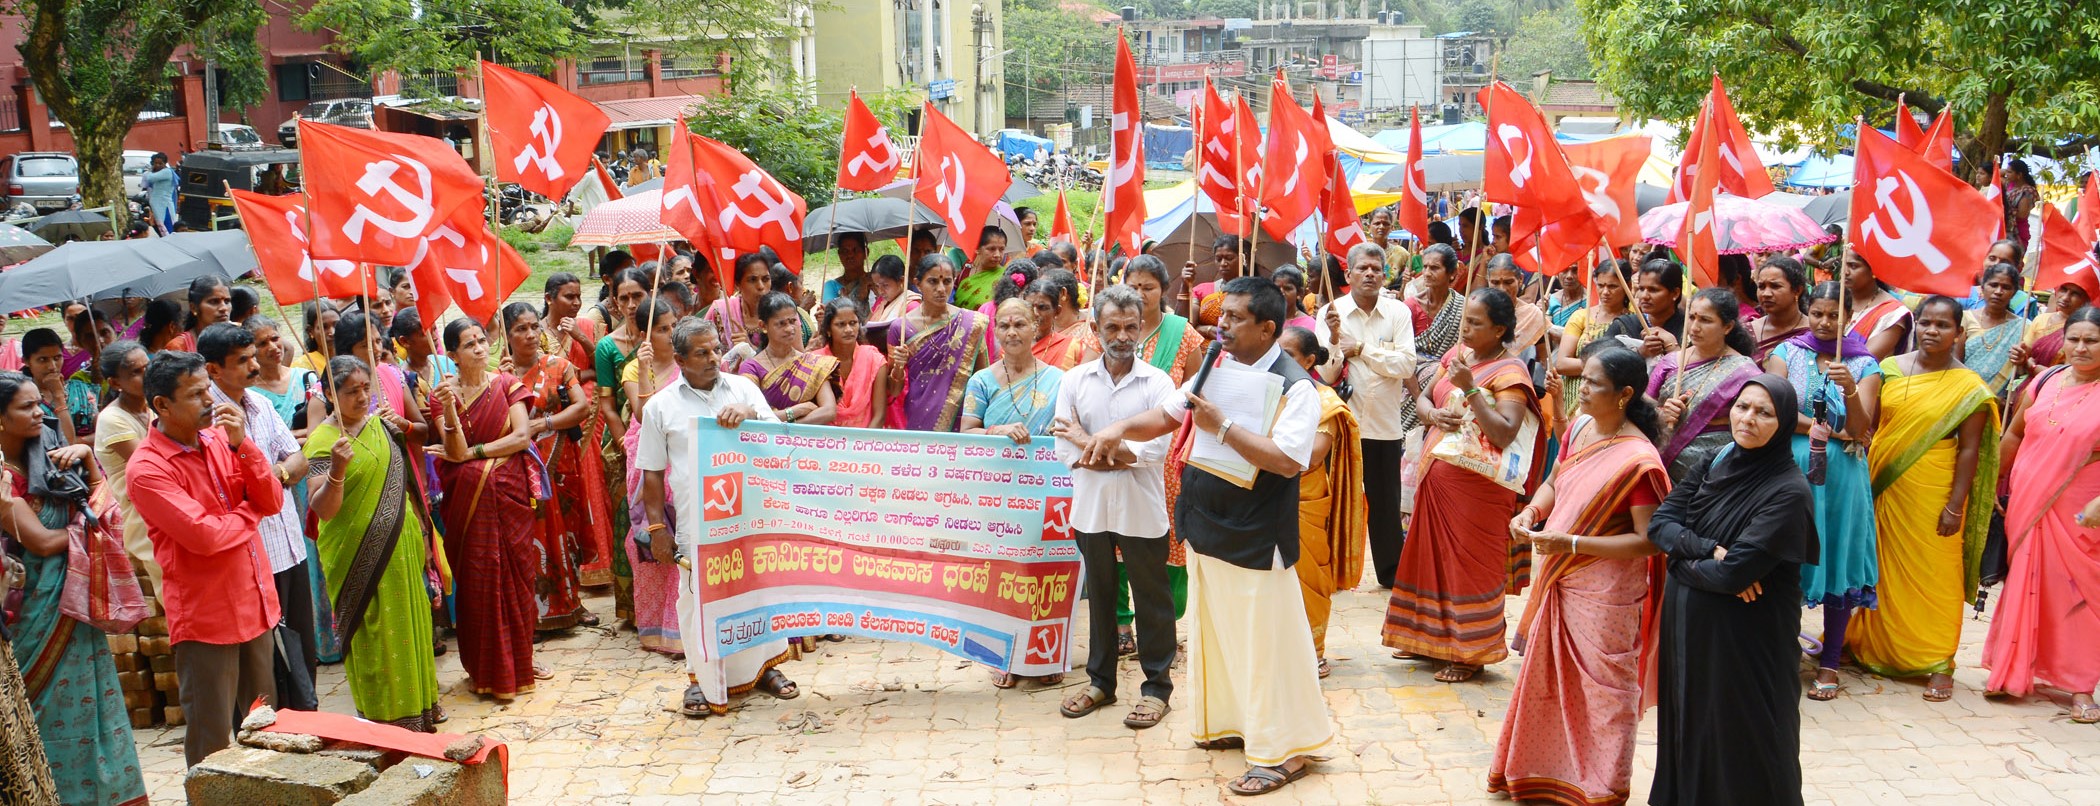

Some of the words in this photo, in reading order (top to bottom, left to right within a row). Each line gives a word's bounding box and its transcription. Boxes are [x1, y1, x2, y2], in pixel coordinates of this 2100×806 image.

[740, 432, 768, 444] ಬೀಡಿ
[775, 434, 847, 450] ಕಾರ್ಮಿಕರಿಗೆ
[853, 439, 920, 454] ನಿಗದಿಯಾದ
[712, 452, 747, 467] 1000
[752, 456, 791, 470] ಬೀಡಿಗೆ
[798, 458, 822, 471] ರೂ.
[891, 463, 922, 477] ಕಳೆದ
[928, 466, 938, 478] 3
[944, 466, 1012, 484] ವರ್ಷಗಳಿಂದ
[1018, 473, 1045, 486] ಬಾಕಿ
[792, 483, 854, 497] ಕಾರ್ಮಿಕರಿಗೆ
[859, 486, 887, 503] ತಕ್ಷಣ
[892, 488, 928, 502] ನೀಡಲು
[978, 494, 1002, 508] ವಾರ
[1007, 497, 1042, 511] ಪೂರ್ತಿ
[763, 497, 790, 510] ಕೆಲಸ
[795, 504, 829, 520] ಹಾಗೂ
[834, 510, 878, 525] ಎಲ್ಲರಿಗೂ
[944, 516, 981, 531] ನೀಡಲು
[987, 520, 1023, 537] ಆಗ್ರಹಿಸಿ
[709, 524, 739, 538] ದಿನಾಂಕ
[848, 532, 871, 542] ಗಂಟೆ
[972, 543, 993, 554] ಮಿನಿ
[1048, 546, 1076, 557] ಎದುರು
[706, 548, 744, 586] ಬೀಡಿ
[752, 542, 844, 574] ಕಾರ್ಮಿಕರ
[853, 553, 934, 584] ಉಪವಾಸ
[943, 561, 990, 593] ಧರಣಿ
[998, 569, 1071, 621] ಸತ್ಯಾಗ್ರಹ
[770, 609, 821, 632] ತಾಲೂಕು
[827, 611, 854, 627] ಬೀಡಿ
[860, 613, 926, 636] ಕೆಲಸಗಾರರ
[931, 625, 960, 647] ಸಂಘ
